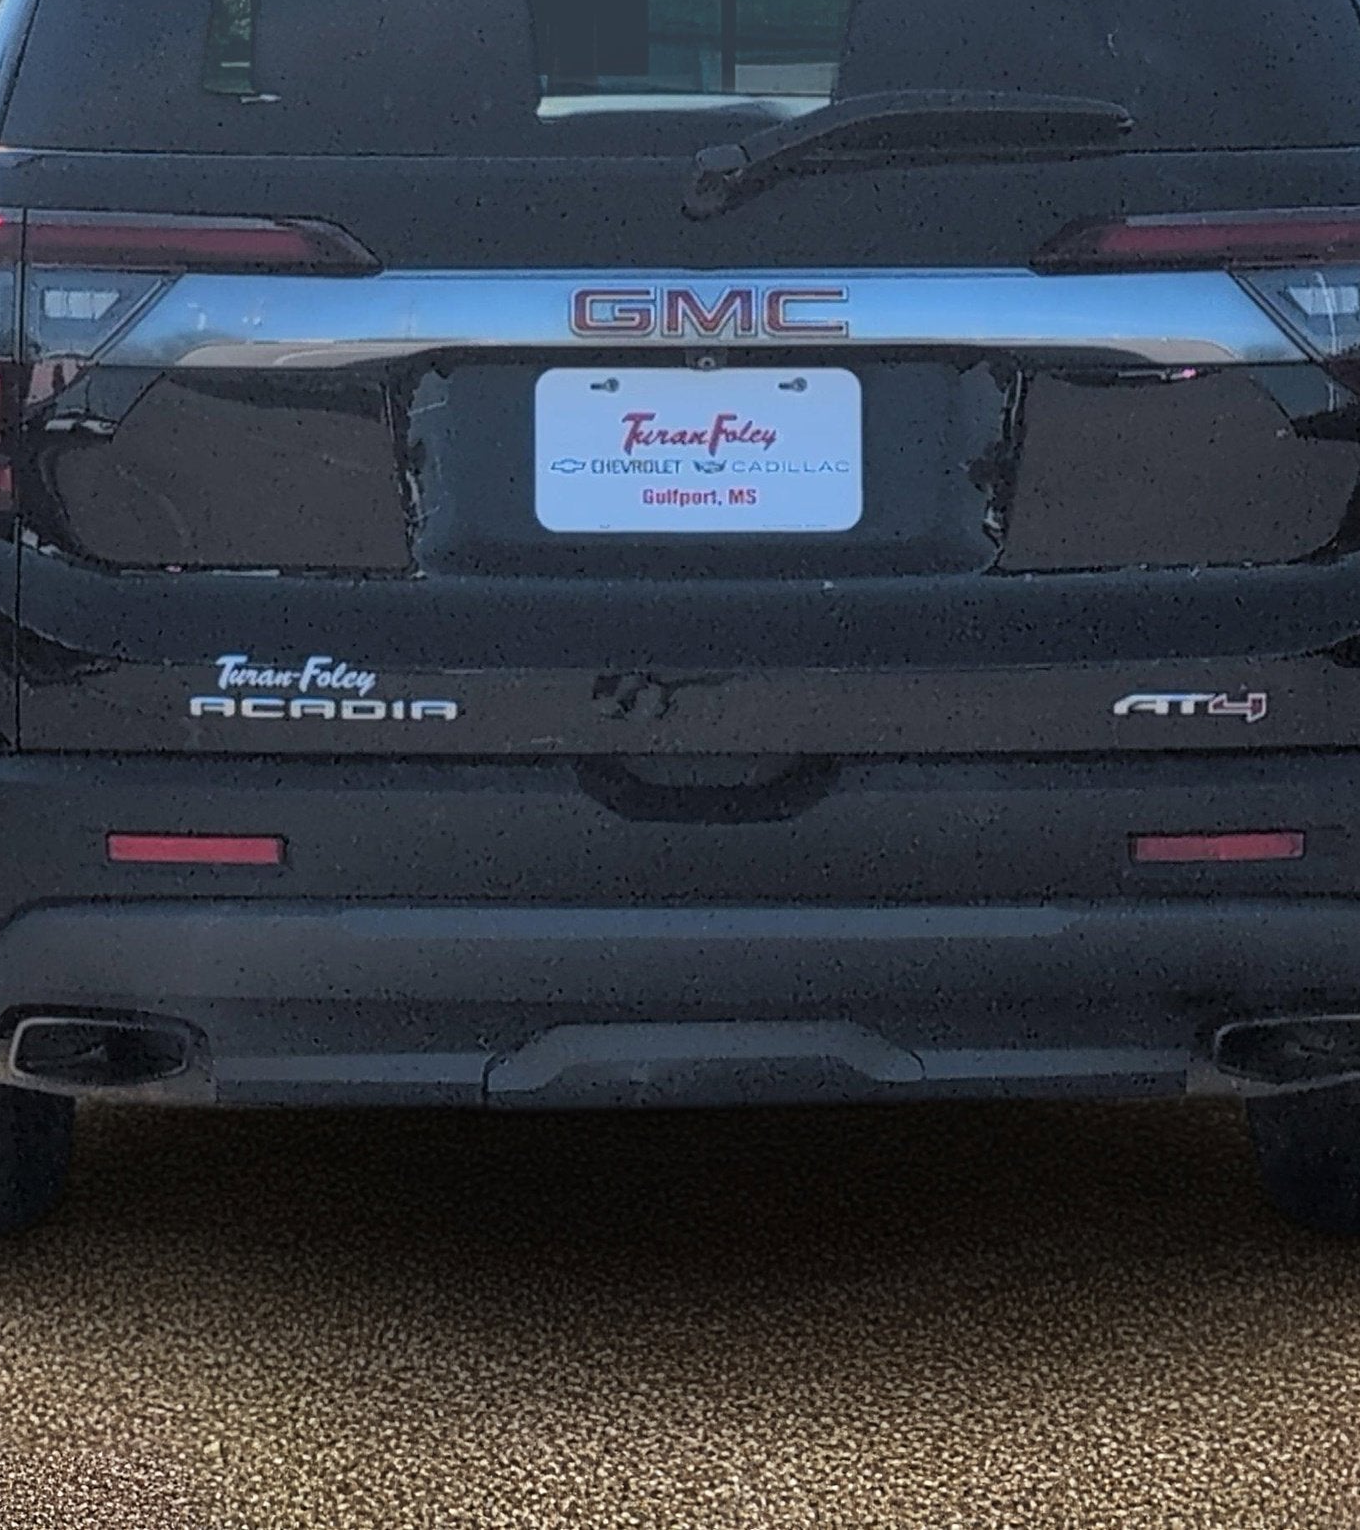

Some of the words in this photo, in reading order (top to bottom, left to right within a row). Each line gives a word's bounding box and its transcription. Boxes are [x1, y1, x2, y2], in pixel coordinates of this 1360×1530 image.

[568, 286, 849, 338] GMC
[591, 459, 682, 474] CHEVROLET
[732, 460, 850, 473] CADILLAC
[642, 488, 722, 507] Gulfport,
[728, 489, 757, 505] MS
[190, 696, 457, 720] ACADIA
[1113, 692, 1267, 722] AT4
